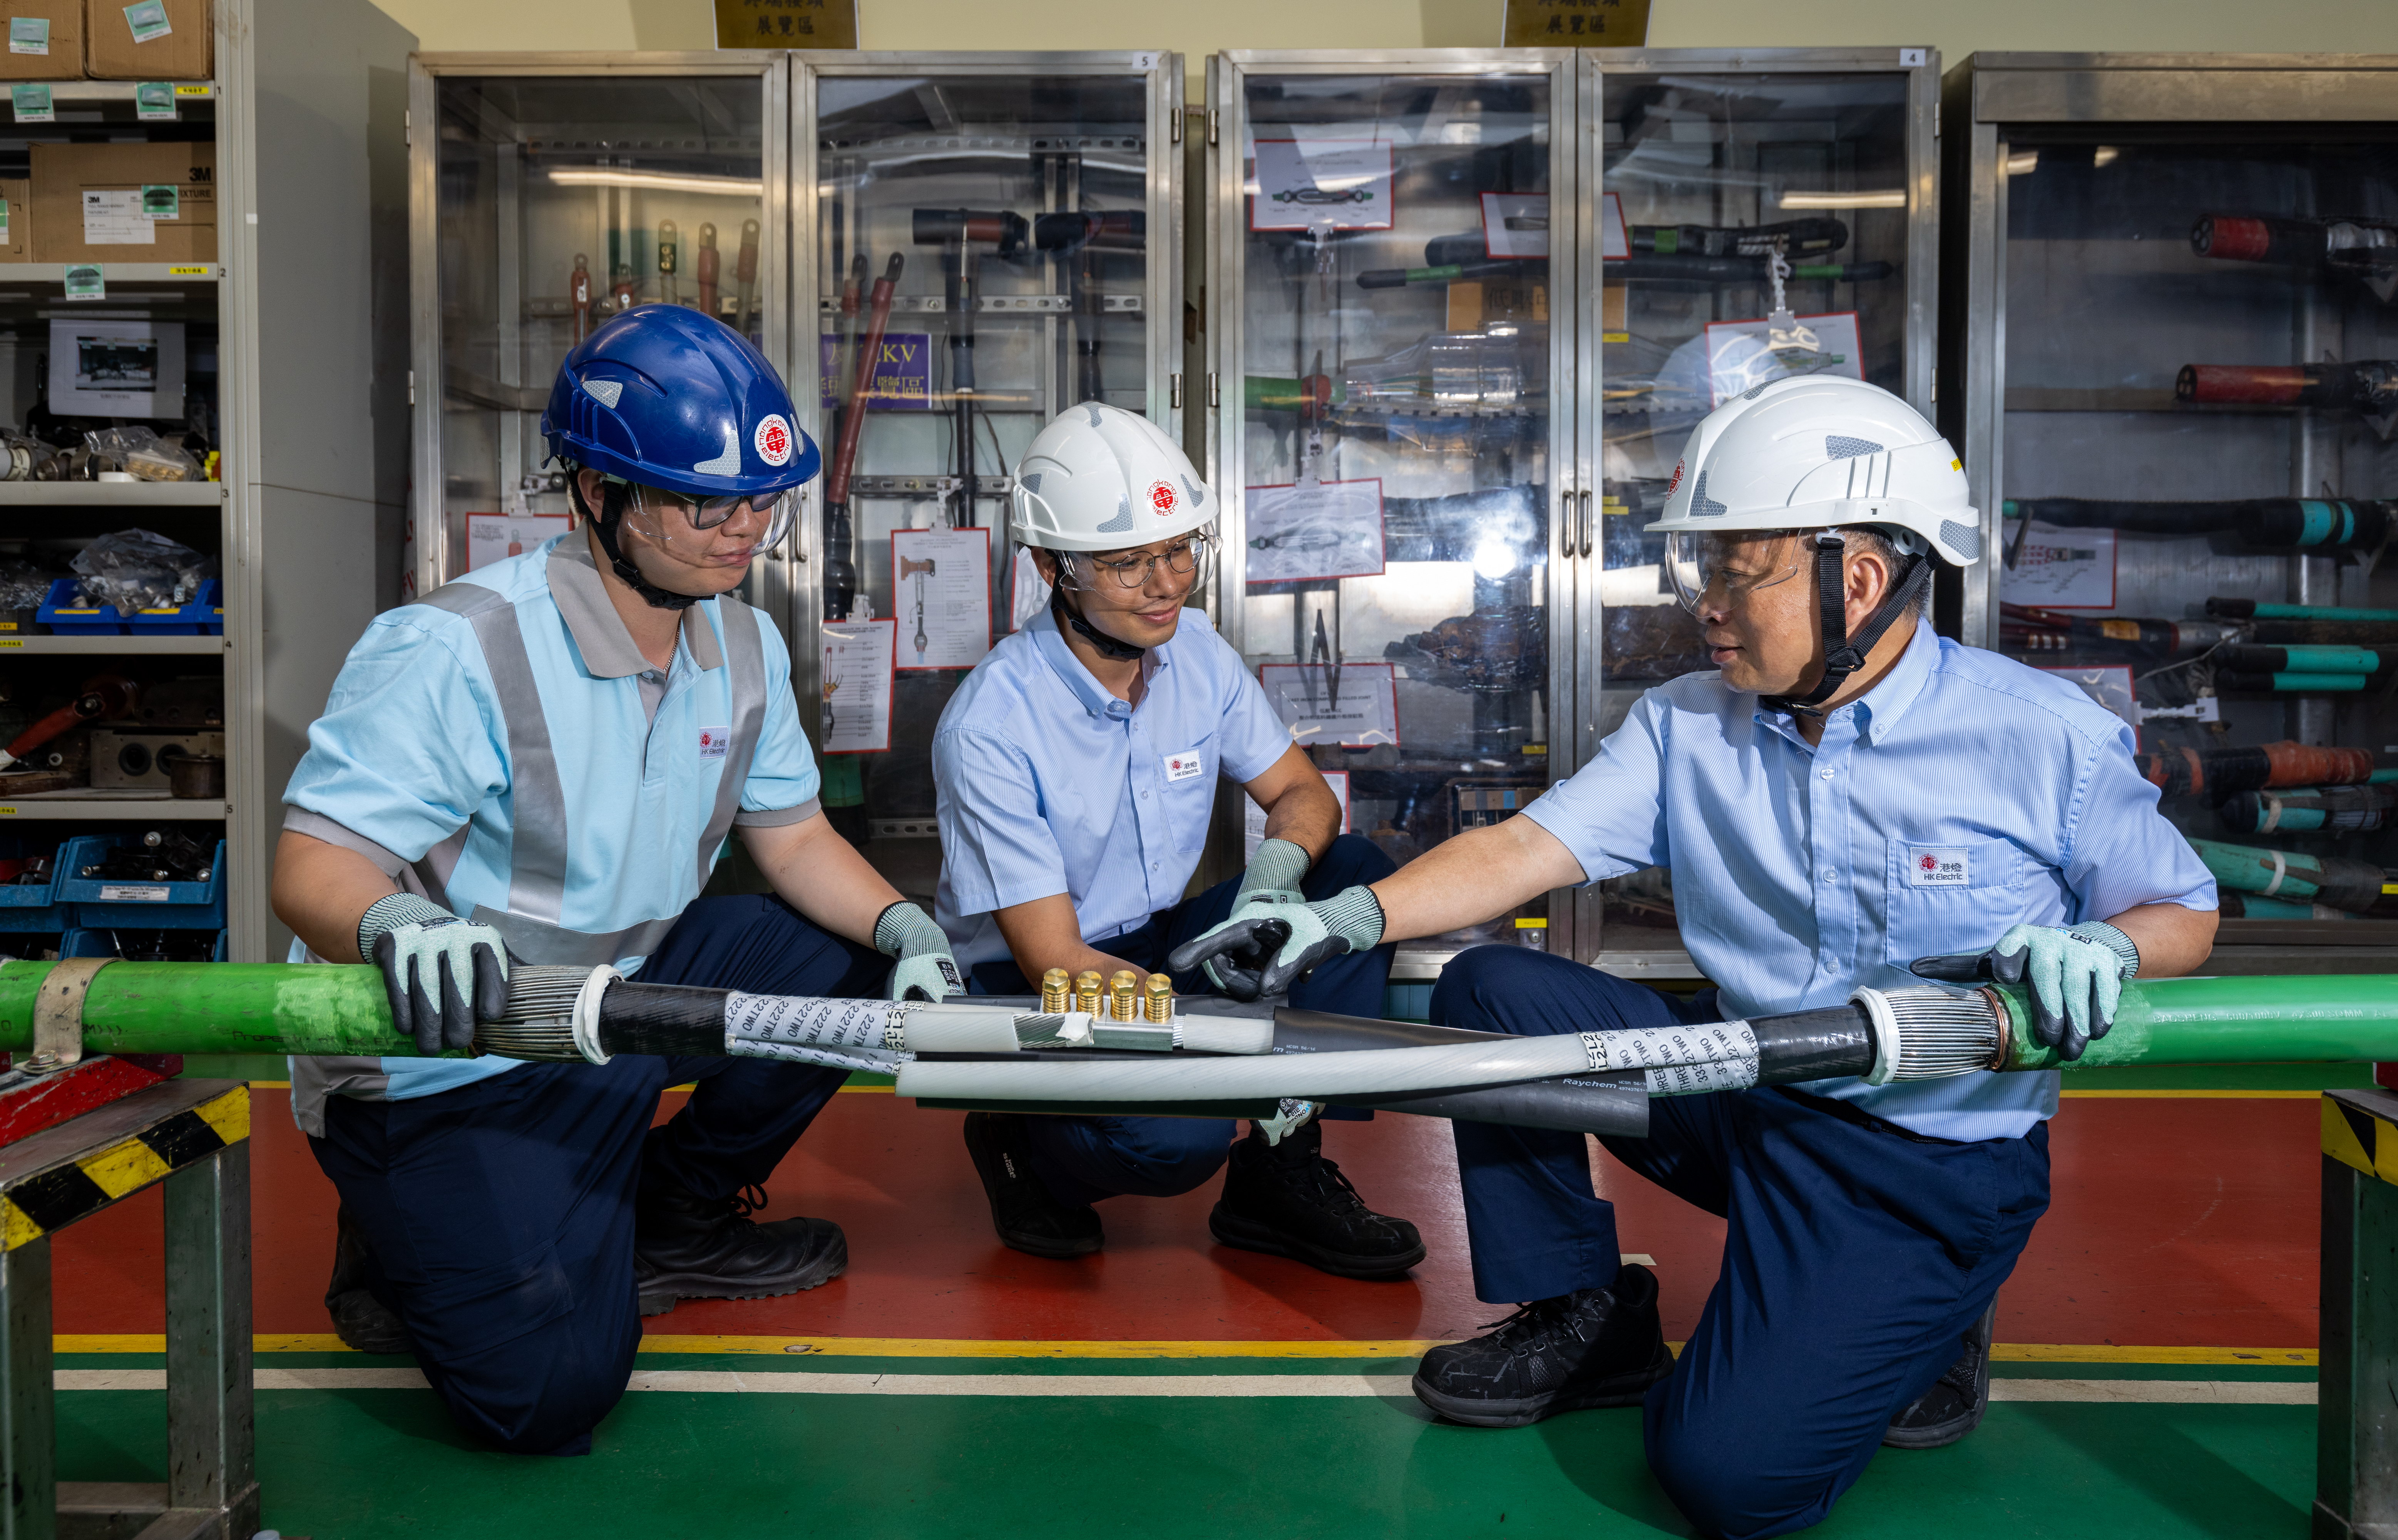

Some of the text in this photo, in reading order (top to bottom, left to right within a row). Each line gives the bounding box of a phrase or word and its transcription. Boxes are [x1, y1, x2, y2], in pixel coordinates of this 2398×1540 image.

[756, 15, 815, 36] 展覽區
[1546, 15, 1605, 35] 展覽區
[1142, 57, 1148, 66] 5
[1909, 54, 1916, 63] 4
[217, 86, 221, 95] 1
[189, 167, 211, 181] 3M
[179, 189, 211, 198] IXTURE
[220, 269, 226, 277] 2
[223, 489, 229, 497] 3
[713, 740, 726, 748] 港燈
[1183, 761, 1197, 769] 港燈
[227, 805, 233, 813] 5
[1940, 863, 1962, 872] 港燈
[2152, 1013, 2217, 1024] BAOSHENG
[1563, 1078, 1617, 1089] Raychem
